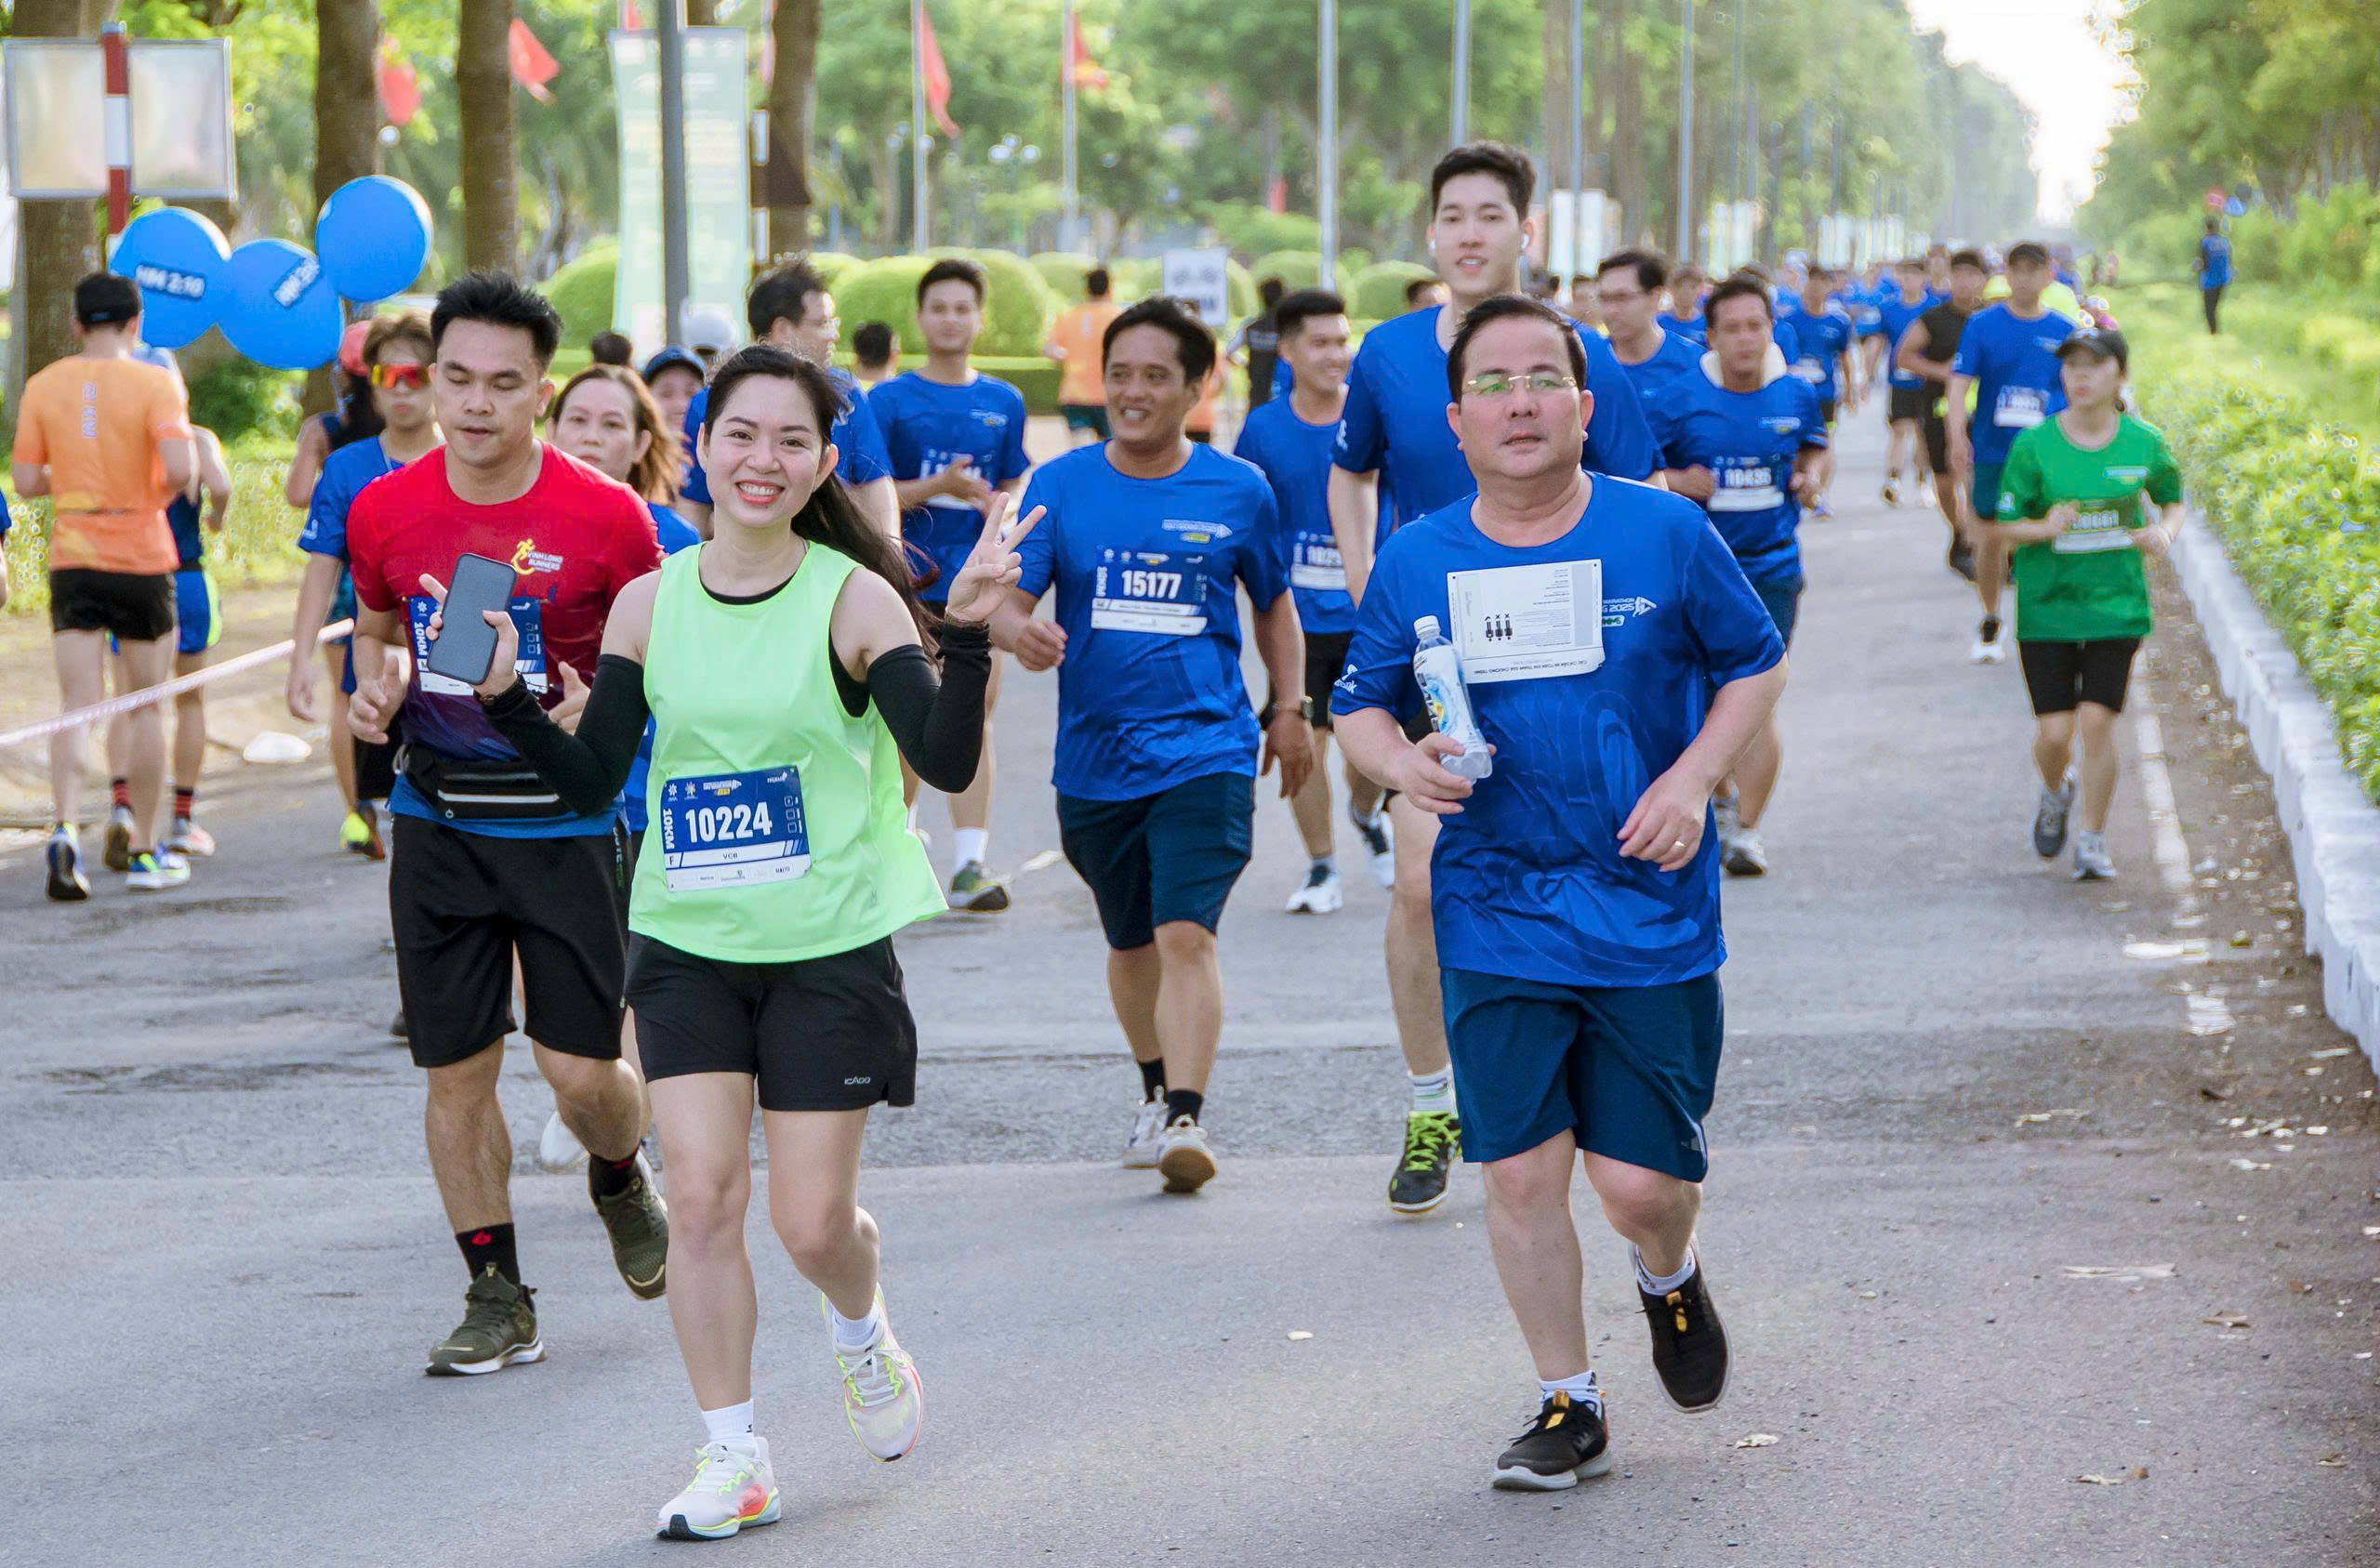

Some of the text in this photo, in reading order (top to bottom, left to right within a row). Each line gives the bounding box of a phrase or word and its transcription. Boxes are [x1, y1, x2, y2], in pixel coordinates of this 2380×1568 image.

[1121, 569, 1183, 600] 15177
[1609, 602, 1635, 613] 2025
[414, 622, 429, 656] 10KM
[663, 808, 675, 850] 10KM
[685, 801, 773, 843] 10224
[669, 856, 675, 865] F
